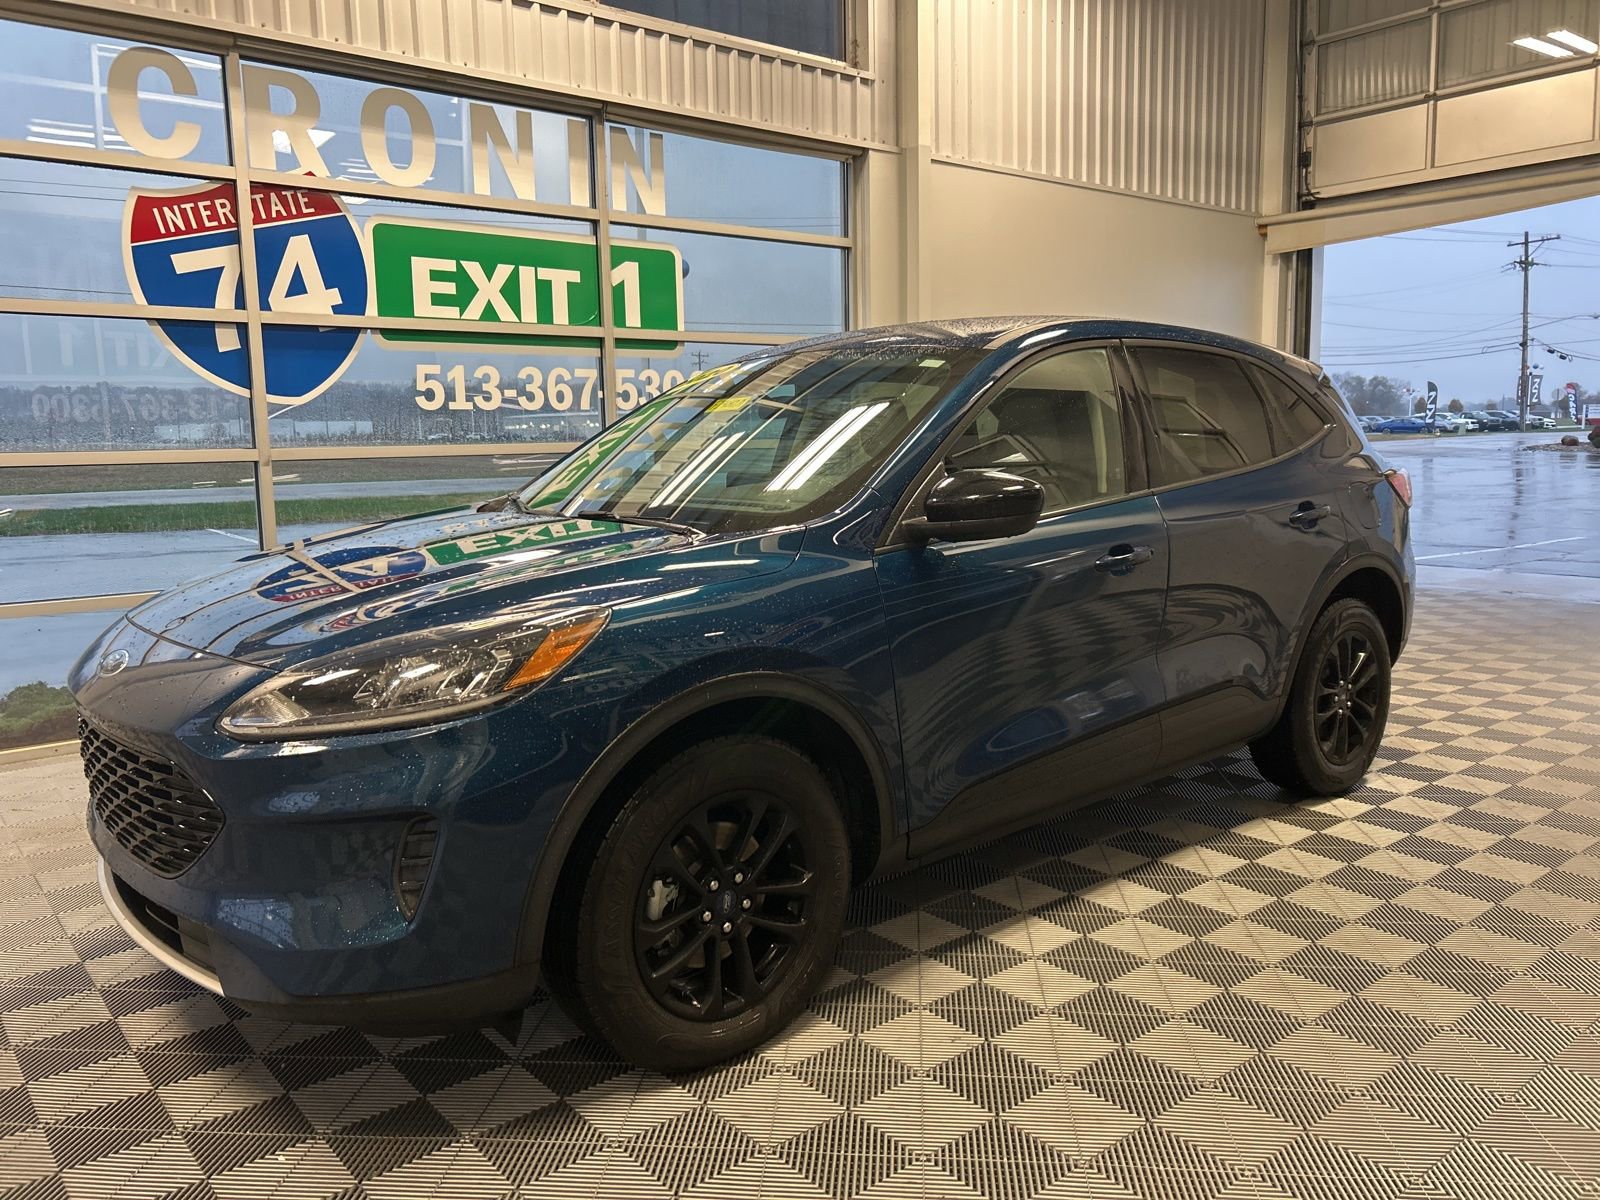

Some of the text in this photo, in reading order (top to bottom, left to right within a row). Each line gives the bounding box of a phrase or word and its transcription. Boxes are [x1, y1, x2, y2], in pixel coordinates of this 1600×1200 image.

[107, 46, 667, 217] CRONIN
[152, 189, 316, 235] INTERTATE
[170, 233, 343, 353] 74
[411, 256, 642, 328] EXIT 1
[415, 363, 704, 412] 513-367530
